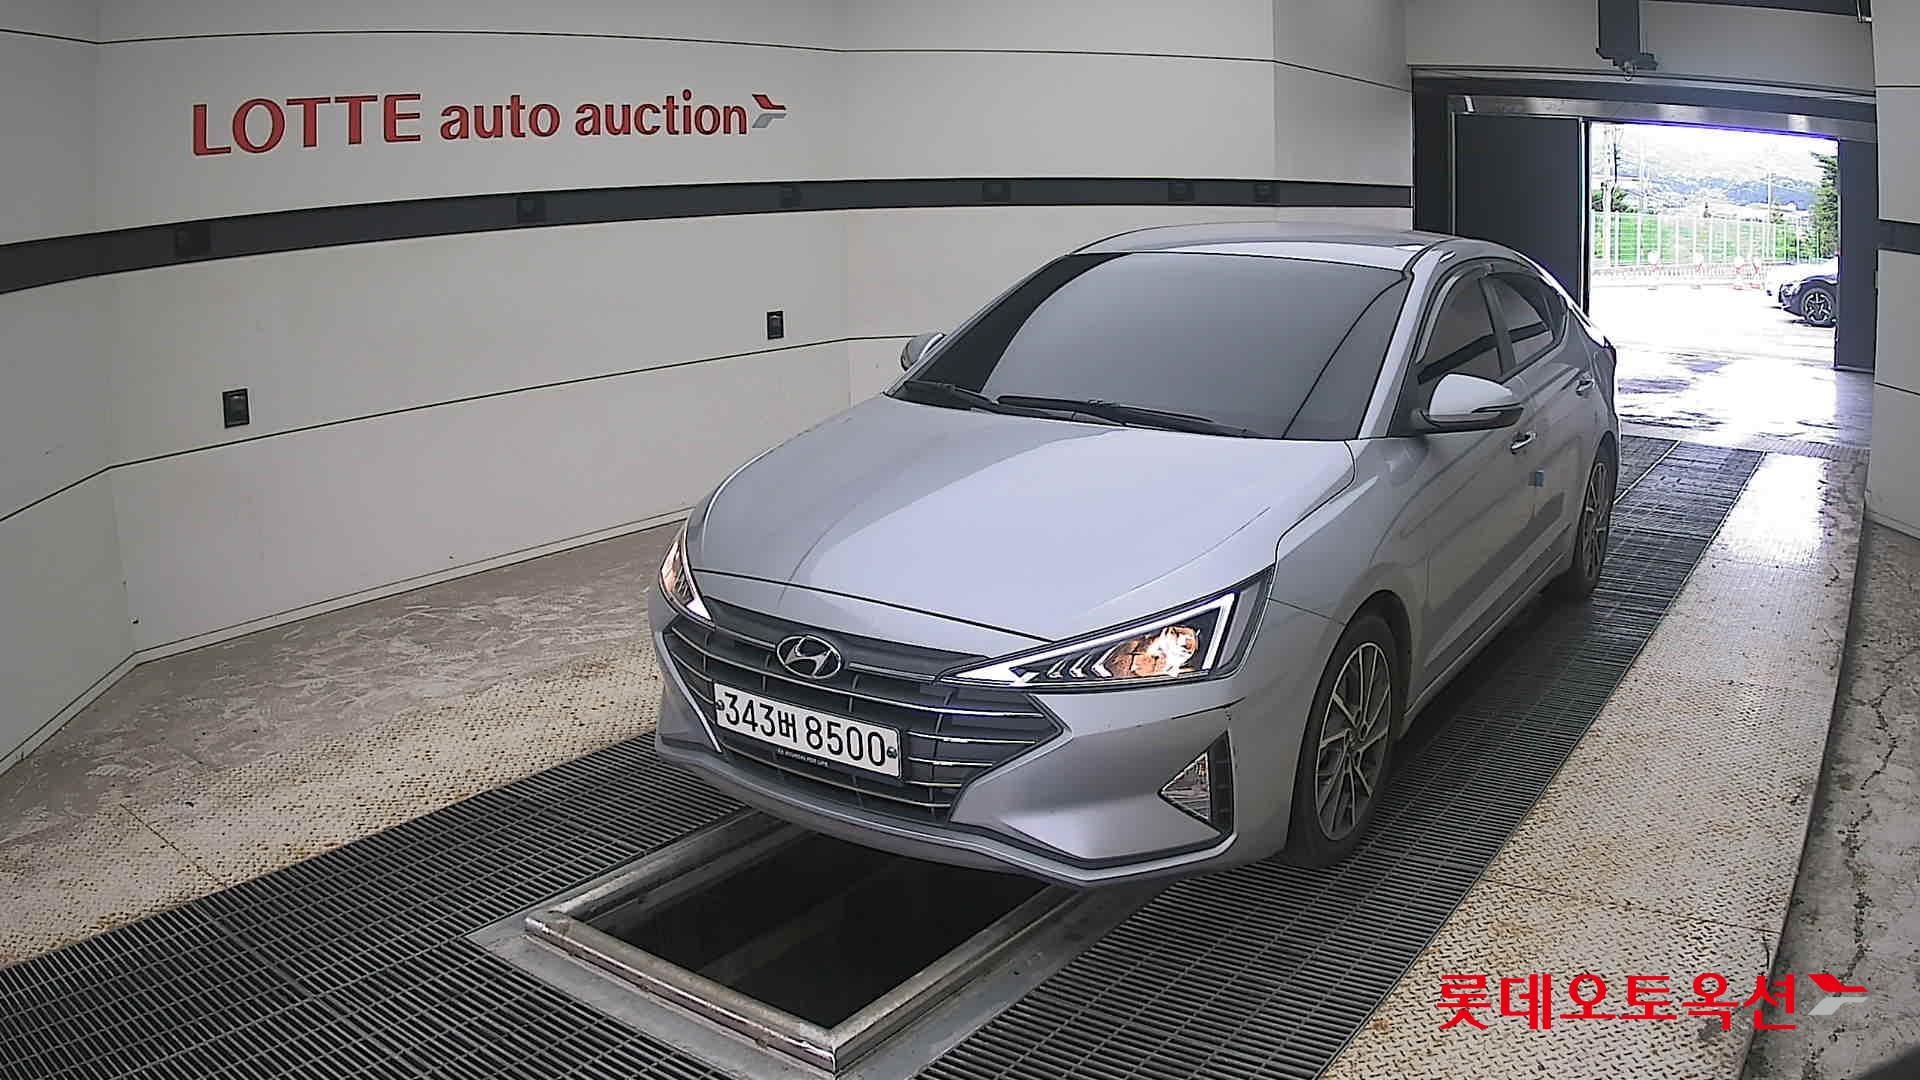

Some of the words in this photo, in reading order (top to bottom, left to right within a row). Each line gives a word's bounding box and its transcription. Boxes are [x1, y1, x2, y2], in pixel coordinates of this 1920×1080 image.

[193, 93, 421, 156] LOTTE
[440, 94, 560, 139] auto
[575, 90, 747, 136] auction
[724, 692, 797, 743] 343버
[805, 716, 885, 766] 8500
